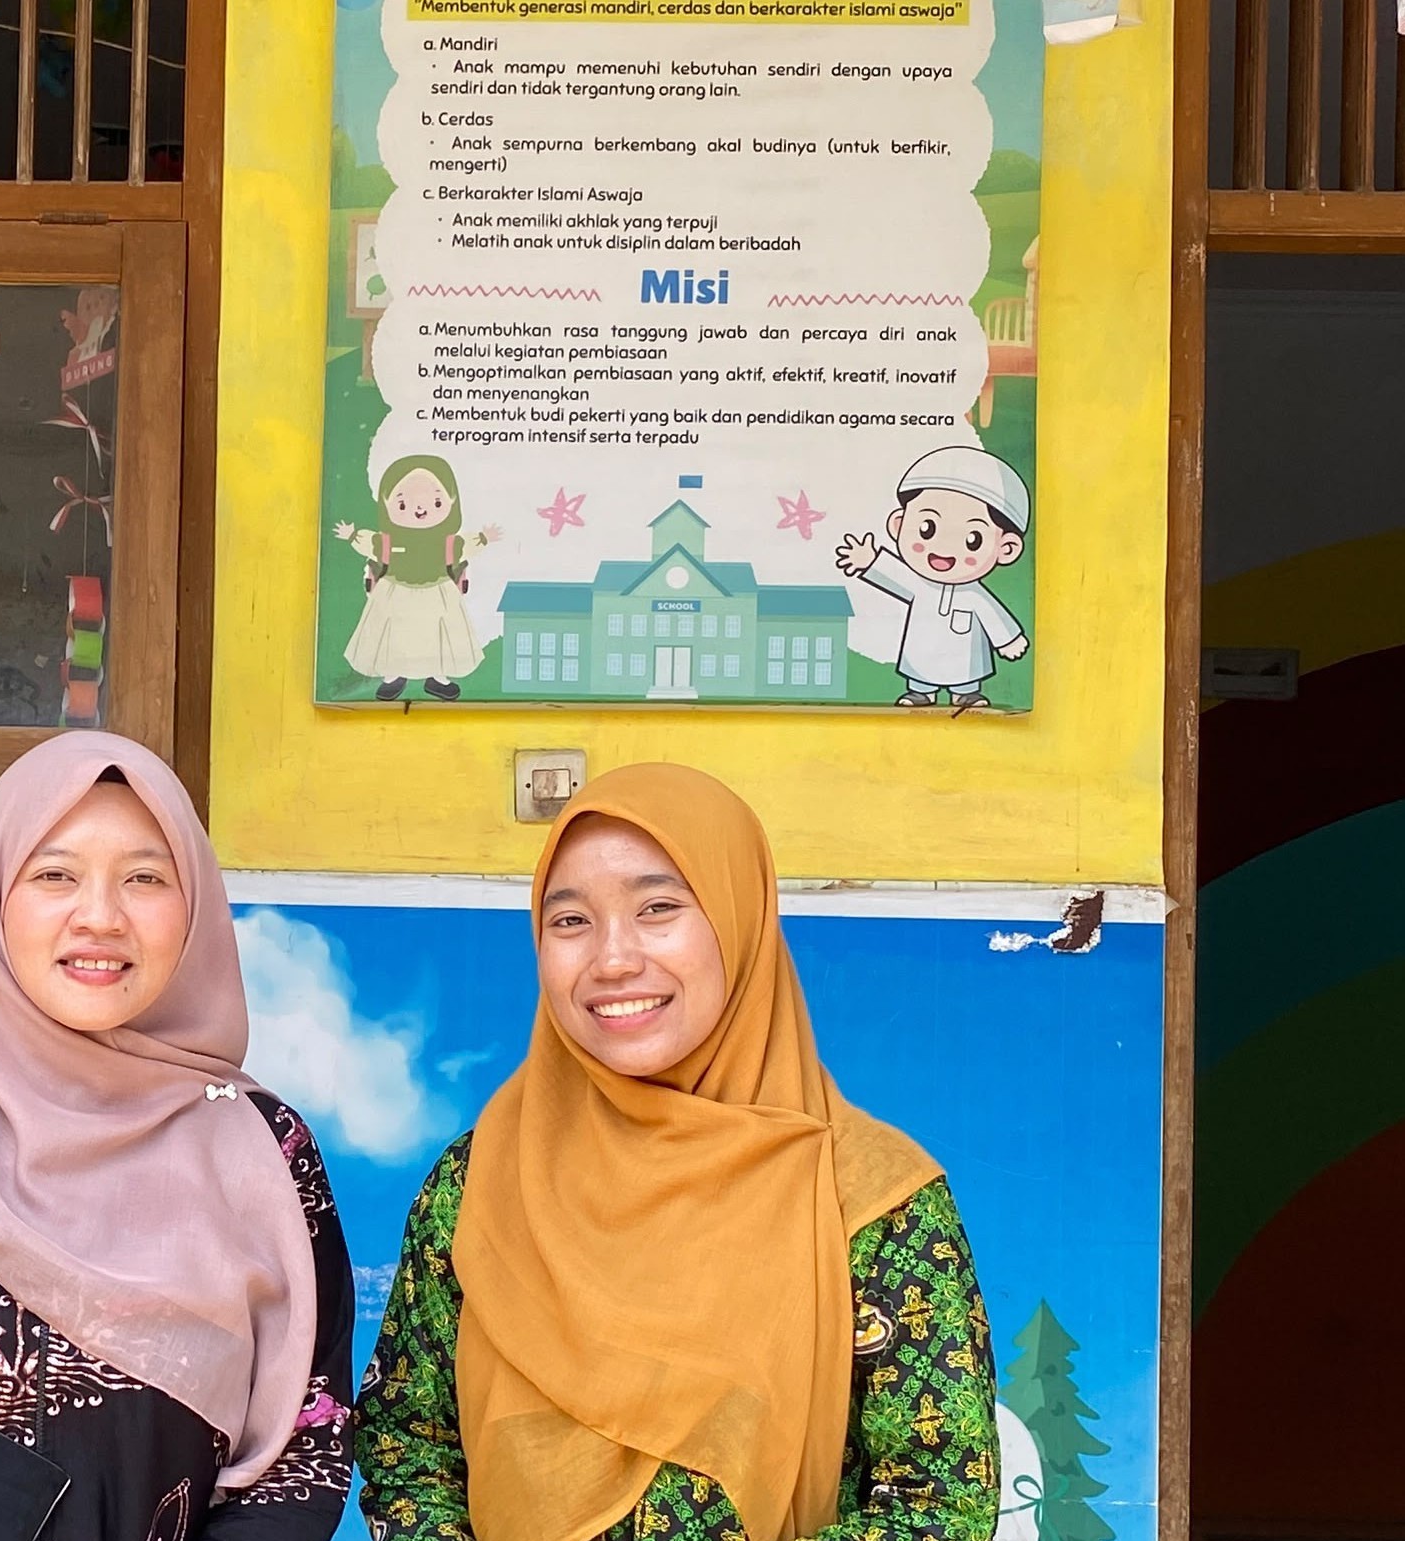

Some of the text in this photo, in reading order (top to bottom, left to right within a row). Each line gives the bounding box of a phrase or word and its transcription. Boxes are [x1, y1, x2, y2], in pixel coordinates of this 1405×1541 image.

[518, 0, 587, 18] generasi
[590, 0, 655, 16] mandiri,
[657, 0, 712, 15] cerdas
[714, 0, 745, 16] dan
[749, 0, 846, 16] berkarakter
[849, 1, 896, 17] islami
[898, 2, 963, 22] aswaja"
[439, 35, 498, 51] Mandiri
[453, 58, 953, 82] Anak mampu memenuhi kebutuhan sendiri dengan upaya
[430, 79, 741, 101] sendiri dan tidak tergantung orang lain.
[438, 110, 494, 127] Cerdas
[451, 135, 951, 157] Anak sempurna berkembang akal budinya (untuk berfikir,
[429, 155, 507, 175] mengerti)
[438, 184, 535, 201] Berkarakter
[537, 186, 584, 201] Islami
[586, 186, 643, 206] Aswaja
[452, 211, 718, 234] Anak memiliki akhlak yang terpuji
[451, 233, 801, 254] Melatih anak untuk disiplin dalam beribadah
[640, 269, 729, 305] Misi
[433, 321, 552, 338] Menumbuhkan
[563, 326, 599, 338] rasa
[610, 324, 688, 343] tanggung
[697, 324, 748, 344] jawab
[758, 324, 790, 340] dan
[801, 329, 868, 344] percaya
[879, 325, 905, 341] diri
[916, 326, 957, 342] anak
[434, 342, 668, 363] melalui kegiatan pembiasaan
[65, 354, 113, 383] BURUNG
[433, 363, 567, 383] Mengoptimalkan
[573, 365, 673, 384] pembiasaan
[679, 369, 720, 385] yang
[725, 366, 766, 384] aktif,
[772, 366, 827, 384] efektif,
[833, 367, 890, 385] kreatif,
[895, 368, 957, 384] inovatif
[432, 384, 590, 405] dan menyenangkan
[431, 405, 527, 422] Membentuk
[530, 406, 565, 422] budi
[568, 406, 625, 426] pekerti
[629, 411, 669, 427] yang
[673, 408, 708, 424] baik
[711, 408, 742, 424] dan
[746, 408, 835, 428] pendidikan
[838, 413, 896, 429] agama
[899, 414, 955, 427] secara
[431, 427, 699, 448] terprogram intensif serta terpadu
[657, 602, 695, 611] SCHOOL
